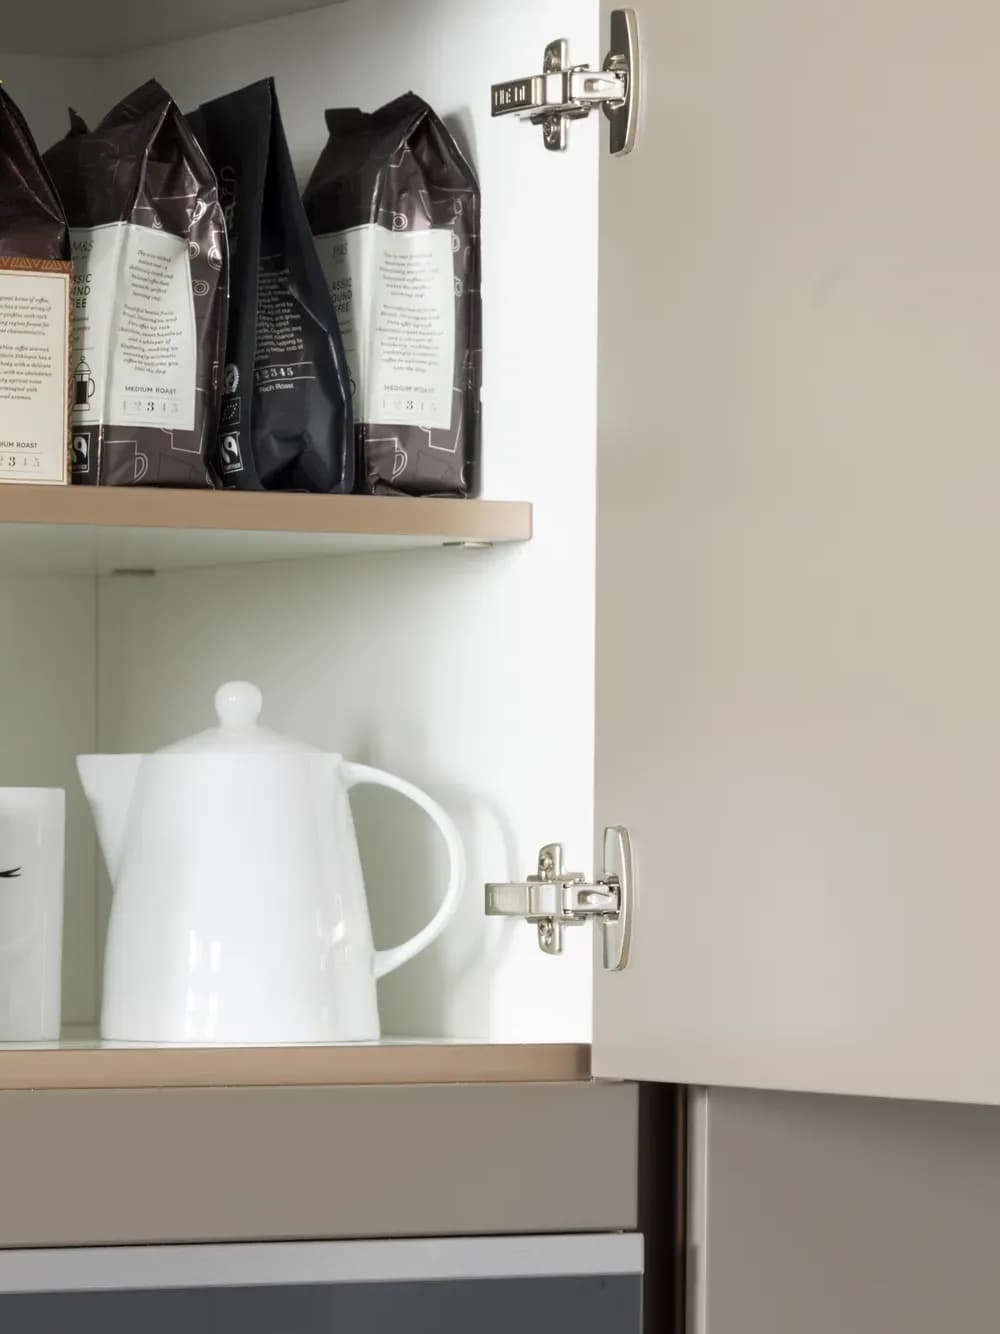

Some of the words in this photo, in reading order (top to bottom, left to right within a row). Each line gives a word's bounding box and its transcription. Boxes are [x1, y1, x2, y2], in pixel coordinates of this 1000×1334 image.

[124, 385, 153, 393] MEDIUM
[155, 386, 177, 396] ROAST
[146, 400, 155, 412] 3
[406, 399, 414, 410] 3
[16, 441, 39, 449] ROAST
[8, 455, 16, 468] 3
